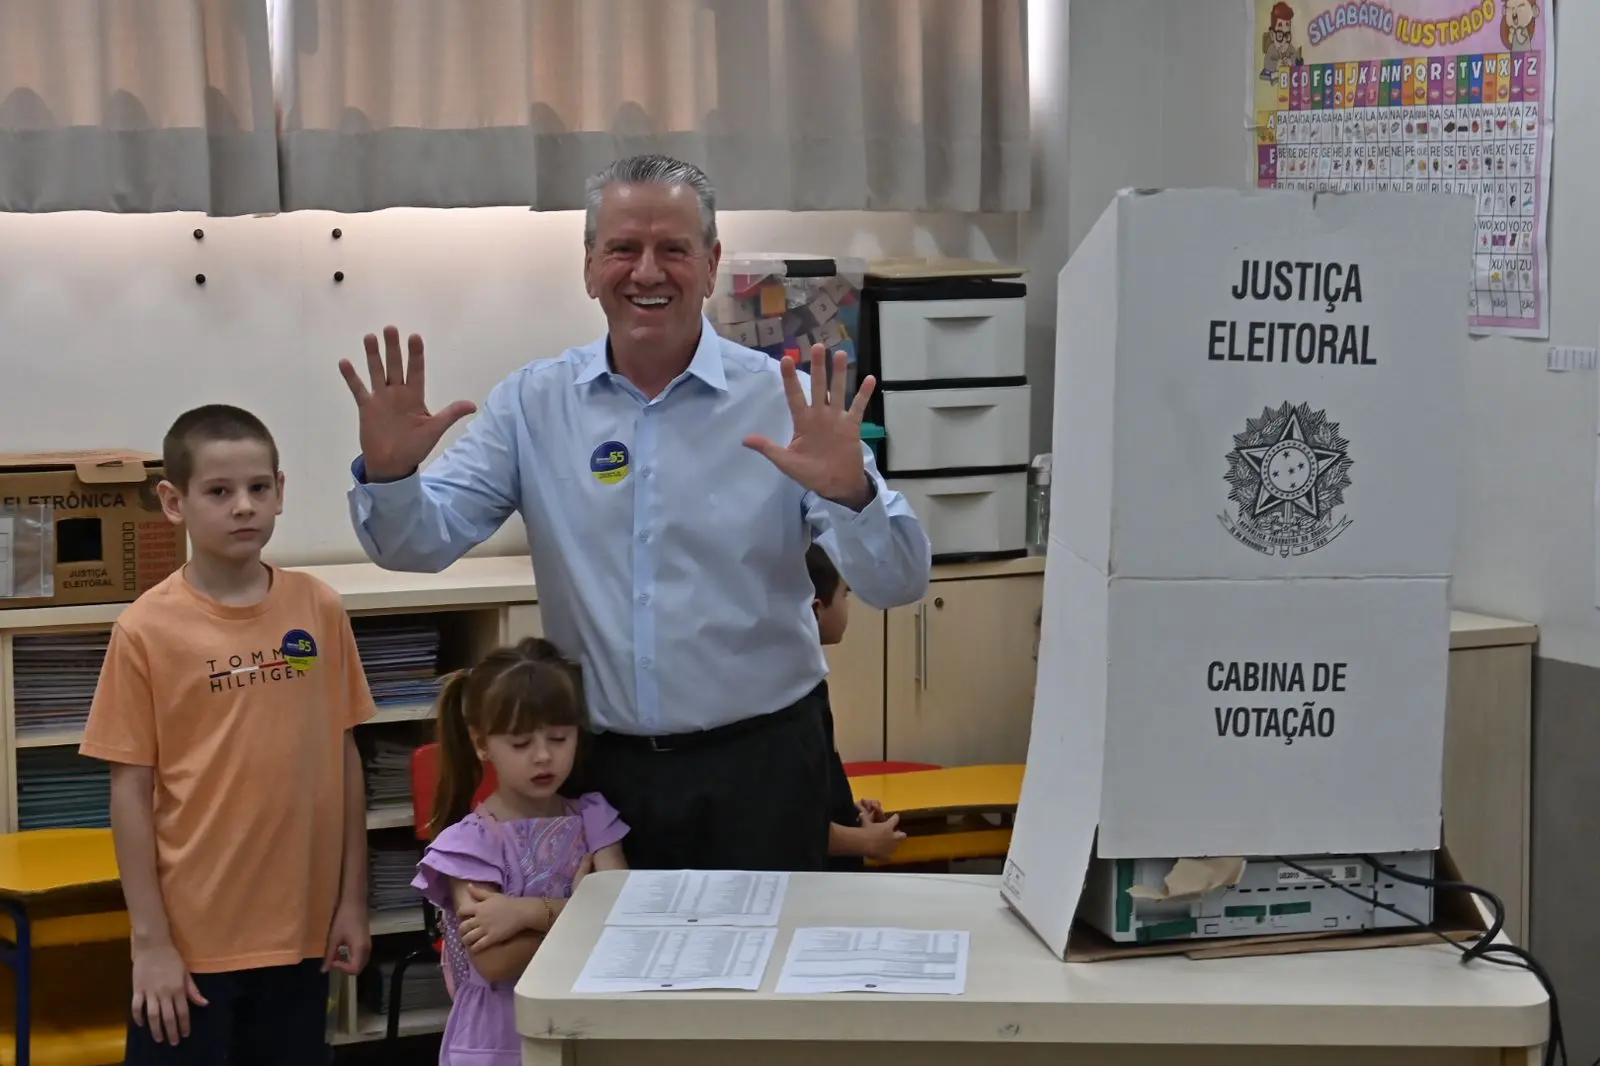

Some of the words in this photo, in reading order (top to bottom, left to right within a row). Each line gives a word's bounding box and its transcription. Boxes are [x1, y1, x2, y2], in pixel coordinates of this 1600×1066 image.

[1395, 0, 1496, 47] ILUSTRADO
[1281, 73, 1287, 88] B
[1292, 71, 1298, 87] C
[1301, 71, 1308, 87] D
[1313, 70, 1320, 87] F
[1324, 69, 1332, 85] G
[1335, 68, 1343, 85] H
[1349, 68, 1356, 84] J
[1359, 67, 1368, 83] K
[1371, 66, 1377, 82] L
[1391, 65, 1401, 82] N
[1404, 64, 1412, 82] P
[1415, 63, 1427, 82] Q
[1430, 63, 1442, 80] R
[1447, 62, 1455, 80] S
[1460, 62, 1468, 79] T
[1472, 61, 1482, 79] V
[1485, 60, 1496, 73] W
[1499, 59, 1509, 77] X
[1514, 59, 1522, 76] Y
[1527, 57, 1537, 75] Z
[1267, 114, 1274, 129] A
[1278, 112, 1287, 123] BA
[1288, 112, 1298, 123] CA
[1312, 112, 1321, 123] FA
[1333, 111, 1342, 122] HA
[1366, 110, 1375, 121] LA
[1390, 109, 1401, 119] NA
[1403, 108, 1414, 119] PA
[1430, 108, 1440, 119] RA
[1444, 108, 1454, 119] SA
[1458, 108, 1467, 119] TA
[1470, 107, 1480, 118] VA
[1483, 108, 1493, 116] WA
[1496, 107, 1506, 117] XA
[1509, 107, 1520, 117] YA
[1525, 106, 1537, 117] ZA
[1269, 148, 1276, 164] E
[1298, 148, 1308, 158] DE
[1311, 147, 1318, 158] FE
[1333, 147, 1342, 157] HE
[1344, 147, 1351, 158] JE
[1355, 146, 1364, 157] KE
[1368, 146, 1376, 157] LE
[1391, 147, 1402, 157] NE
[1405, 146, 1415, 156] PE
[1431, 146, 1440, 156] RE
[1444, 146, 1454, 156] SE
[1458, 145, 1466, 156] TE
[1470, 145, 1480, 156] VE
[1483, 145, 1493, 155] WE
[1496, 145, 1505, 155] XE
[1509, 145, 1519, 155] YE
[1523, 144, 1534, 155] ZE
[1479, 220, 1491, 230] WO
[1493, 220, 1505, 231] XO
[1508, 220, 1519, 232] YO
[1522, 221, 1533, 232] ZO
[1491, 259, 1502, 270] XU
[1505, 259, 1516, 271] YU
[1519, 259, 1531, 271] ZU
[1232, 260, 1362, 313] JUSTIÇA
[1208, 320, 1377, 365] ELEITORAL
[610, 451, 625, 463] 55
[4, 491, 126, 513] ELETRÔNICA
[63, 579, 114, 589] ELEITORAL
[69, 569, 108, 579] JUSTIÇA
[298, 639, 312, 652] 55
[206, 648, 285, 673] TOMM
[1207, 661, 1305, 692] CABINA
[1312, 663, 1347, 692] DE
[1215, 701, 1335, 745] VOTAÇÃO
